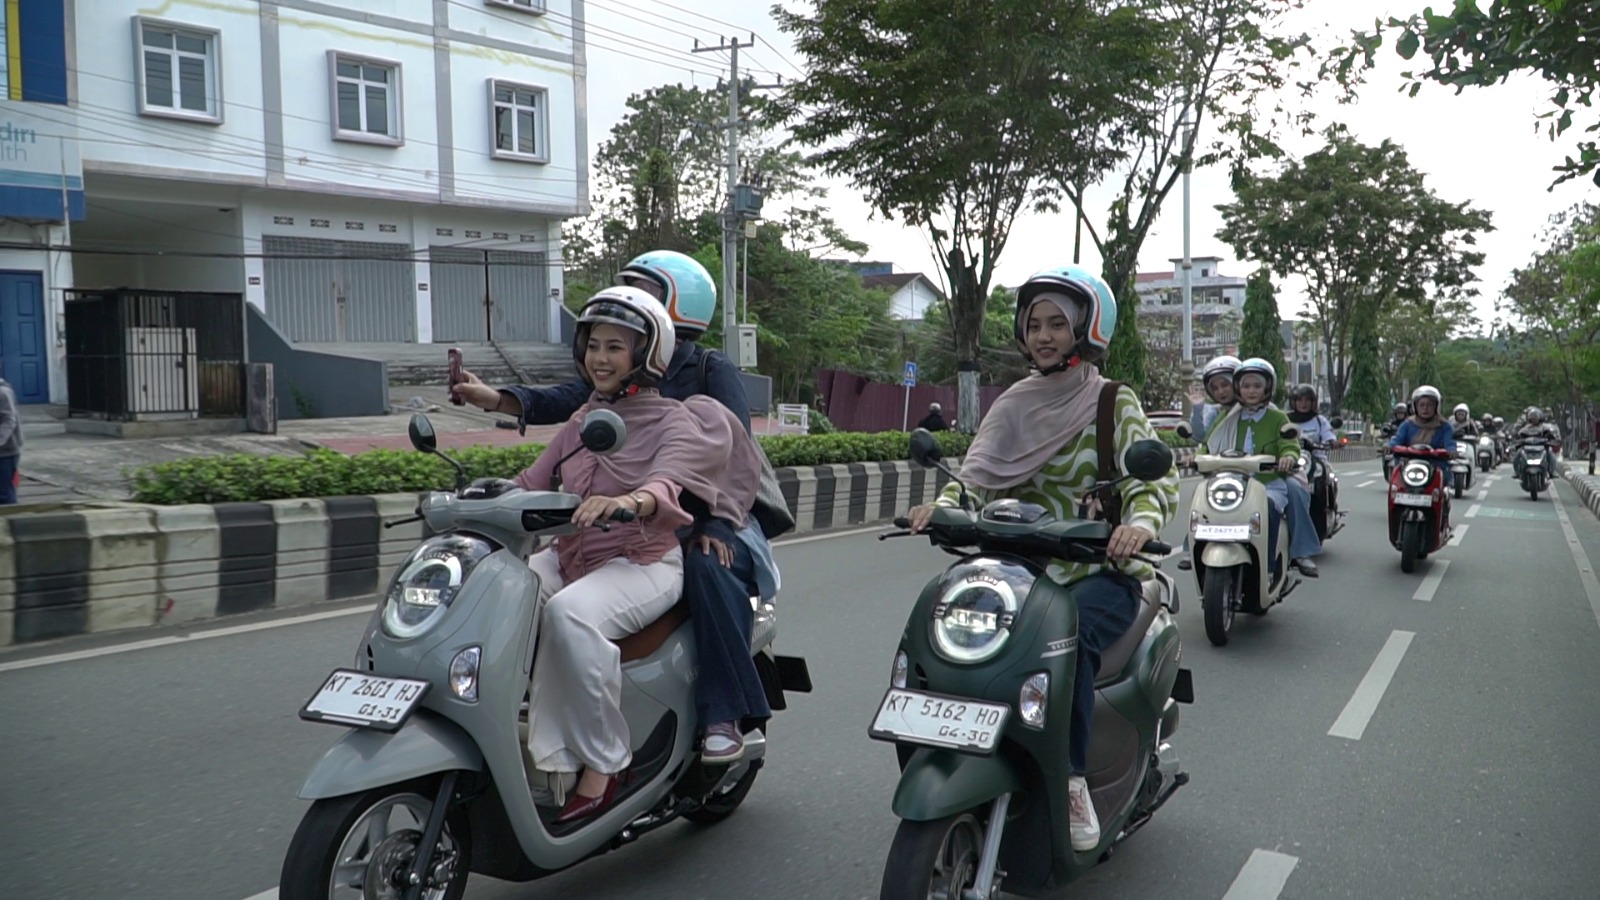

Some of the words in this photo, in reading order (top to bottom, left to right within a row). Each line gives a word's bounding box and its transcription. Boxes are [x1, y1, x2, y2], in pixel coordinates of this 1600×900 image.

[325, 675, 352, 692] KT
[352, 679, 394, 698] 2601
[394, 683, 421, 702] HJ
[886, 694, 913, 712] KT
[920, 700, 967, 721] 5162
[975, 708, 1000, 726] HO
